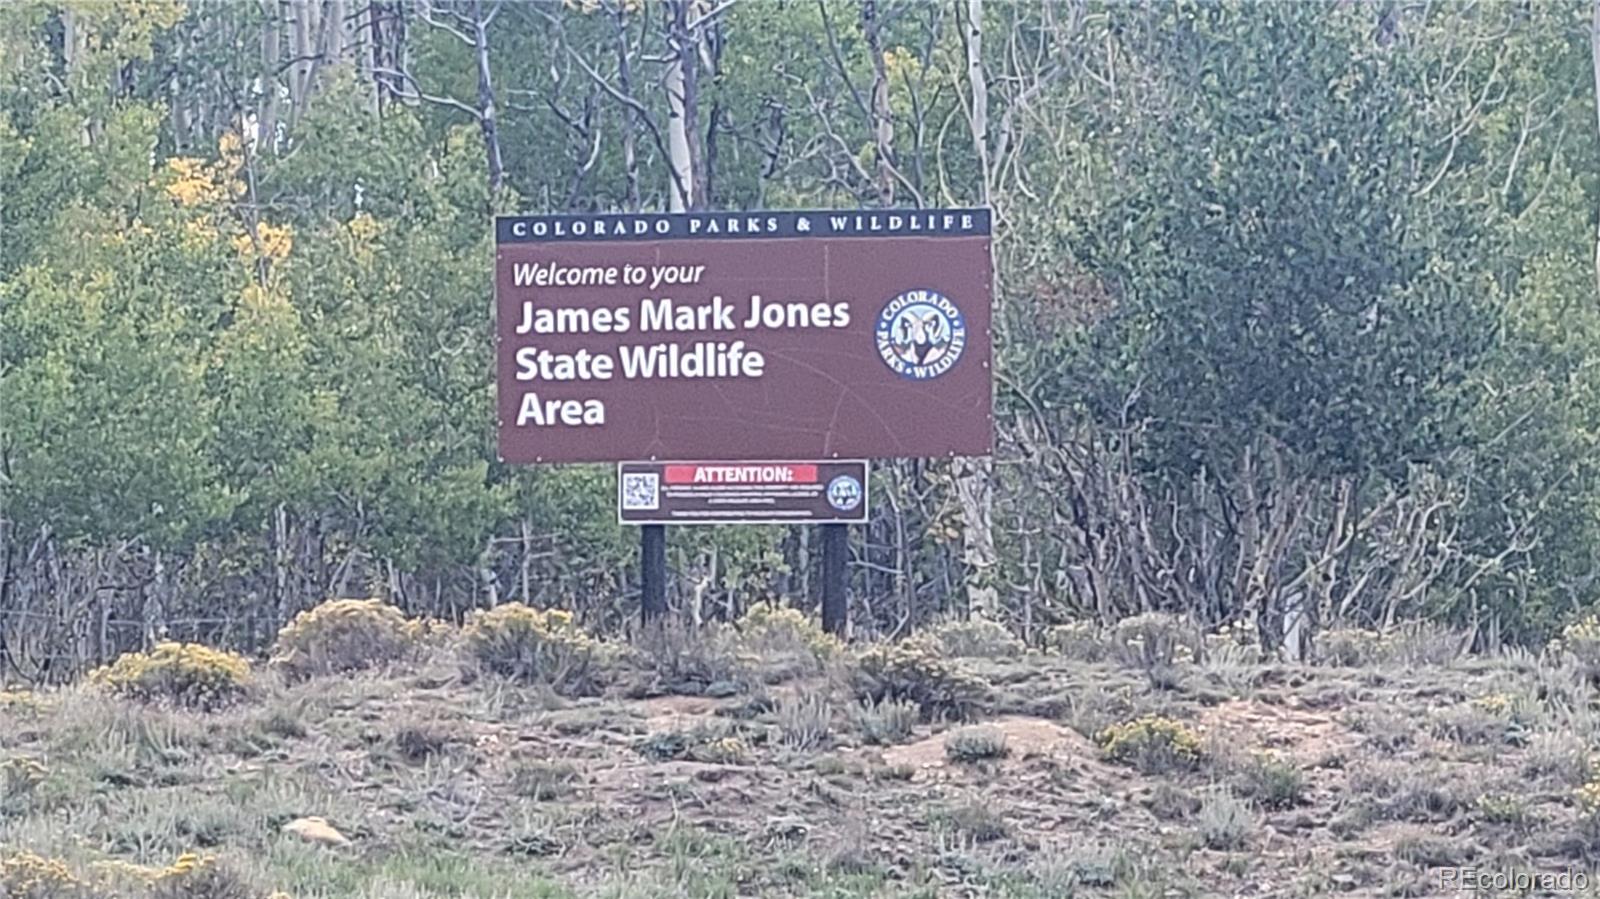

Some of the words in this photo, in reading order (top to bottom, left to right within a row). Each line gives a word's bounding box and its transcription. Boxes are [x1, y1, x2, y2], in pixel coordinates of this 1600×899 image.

[513, 219, 671, 237] COLORADO
[689, 217, 778, 233] PARKS
[796, 217, 811, 232] &
[830, 214, 974, 231] WILDLIFE
[513, 261, 618, 286] Welcome
[623, 264, 646, 285] to
[649, 265, 705, 290] your
[515, 301, 631, 334] James
[640, 296, 736, 331] Mark
[744, 295, 851, 328] Jones
[882, 290, 959, 321] COLORADO
[515, 347, 614, 380] State
[619, 341, 765, 378] Wildlife
[876, 330, 906, 374] PARKS
[912, 327, 966, 379] WILDLIFE
[516, 392, 605, 426] Area
[693, 466, 793, 483] ATTENTION:
